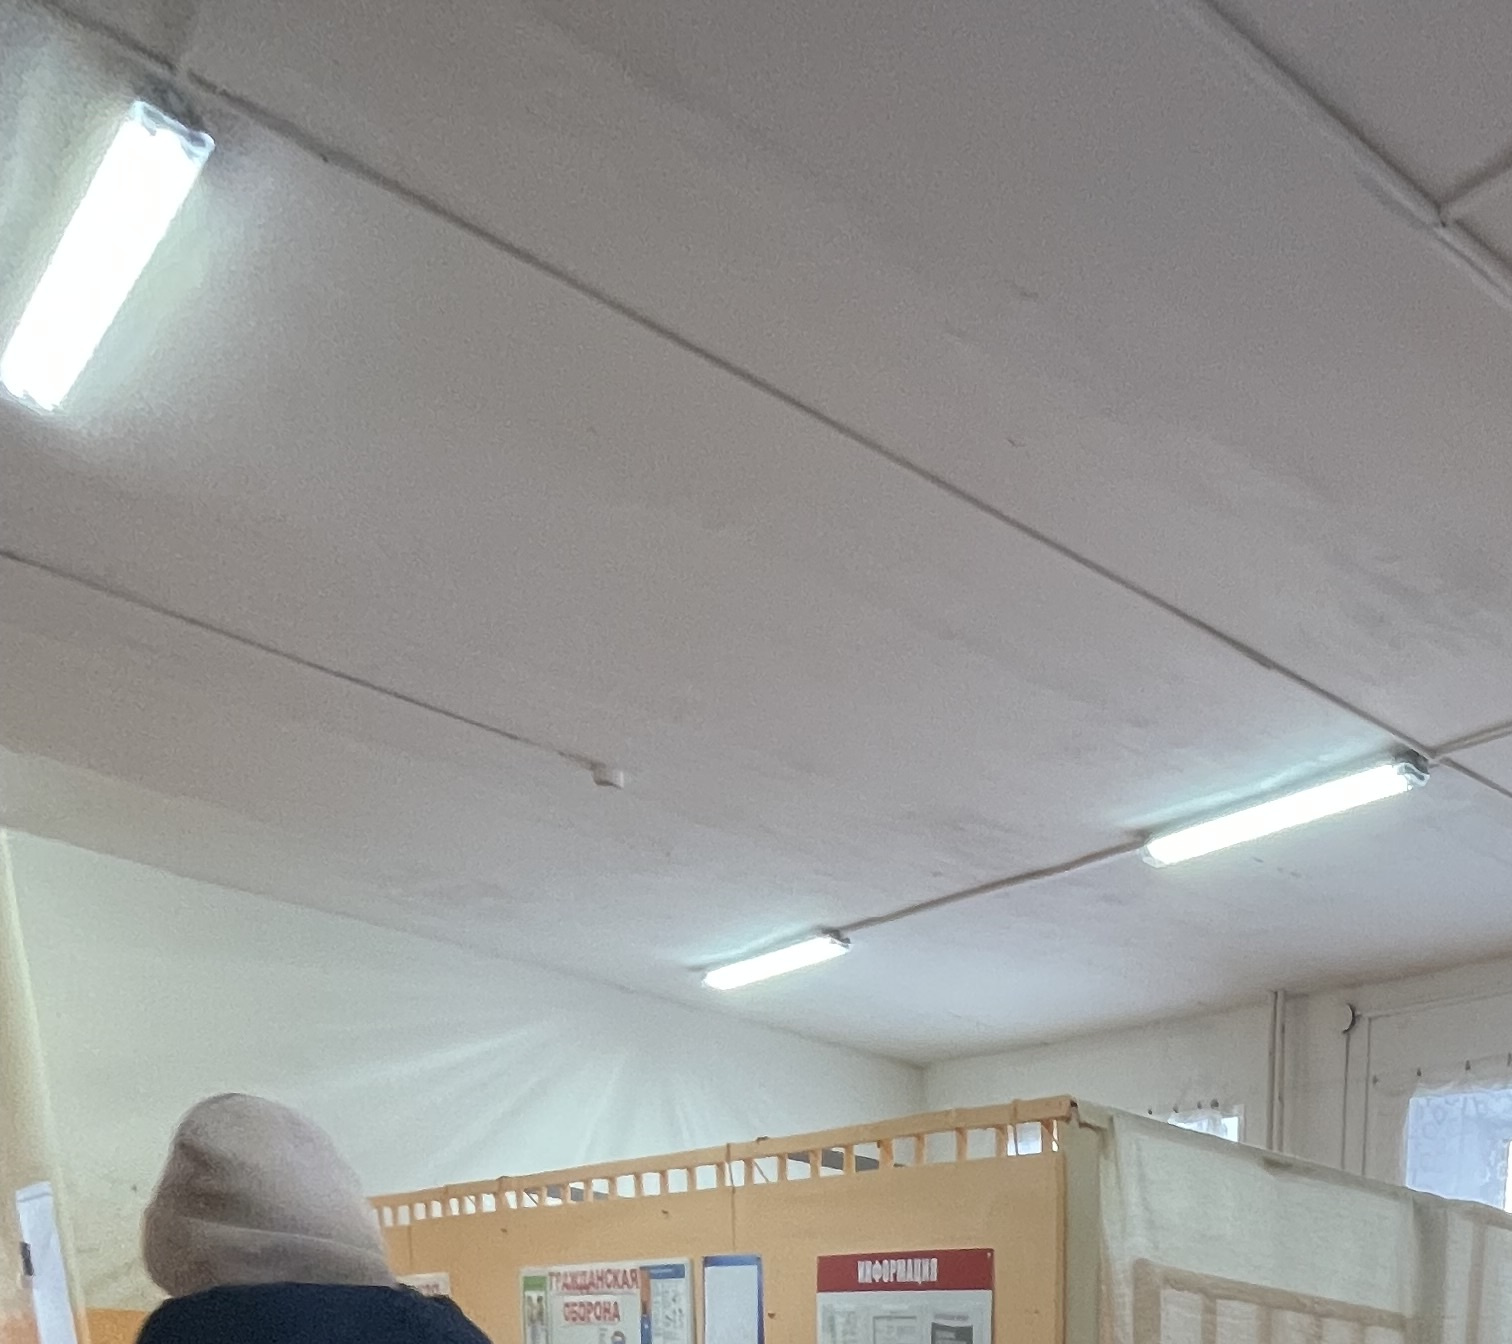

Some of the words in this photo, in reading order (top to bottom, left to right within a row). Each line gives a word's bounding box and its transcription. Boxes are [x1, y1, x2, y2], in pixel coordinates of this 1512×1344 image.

[548, 1268, 640, 1292] ГРАЖДАНСКАЯ
[857, 1257, 938, 1284] ИНФОРМАЦИЯ
[563, 1301, 621, 1322] ОБОРОНА
